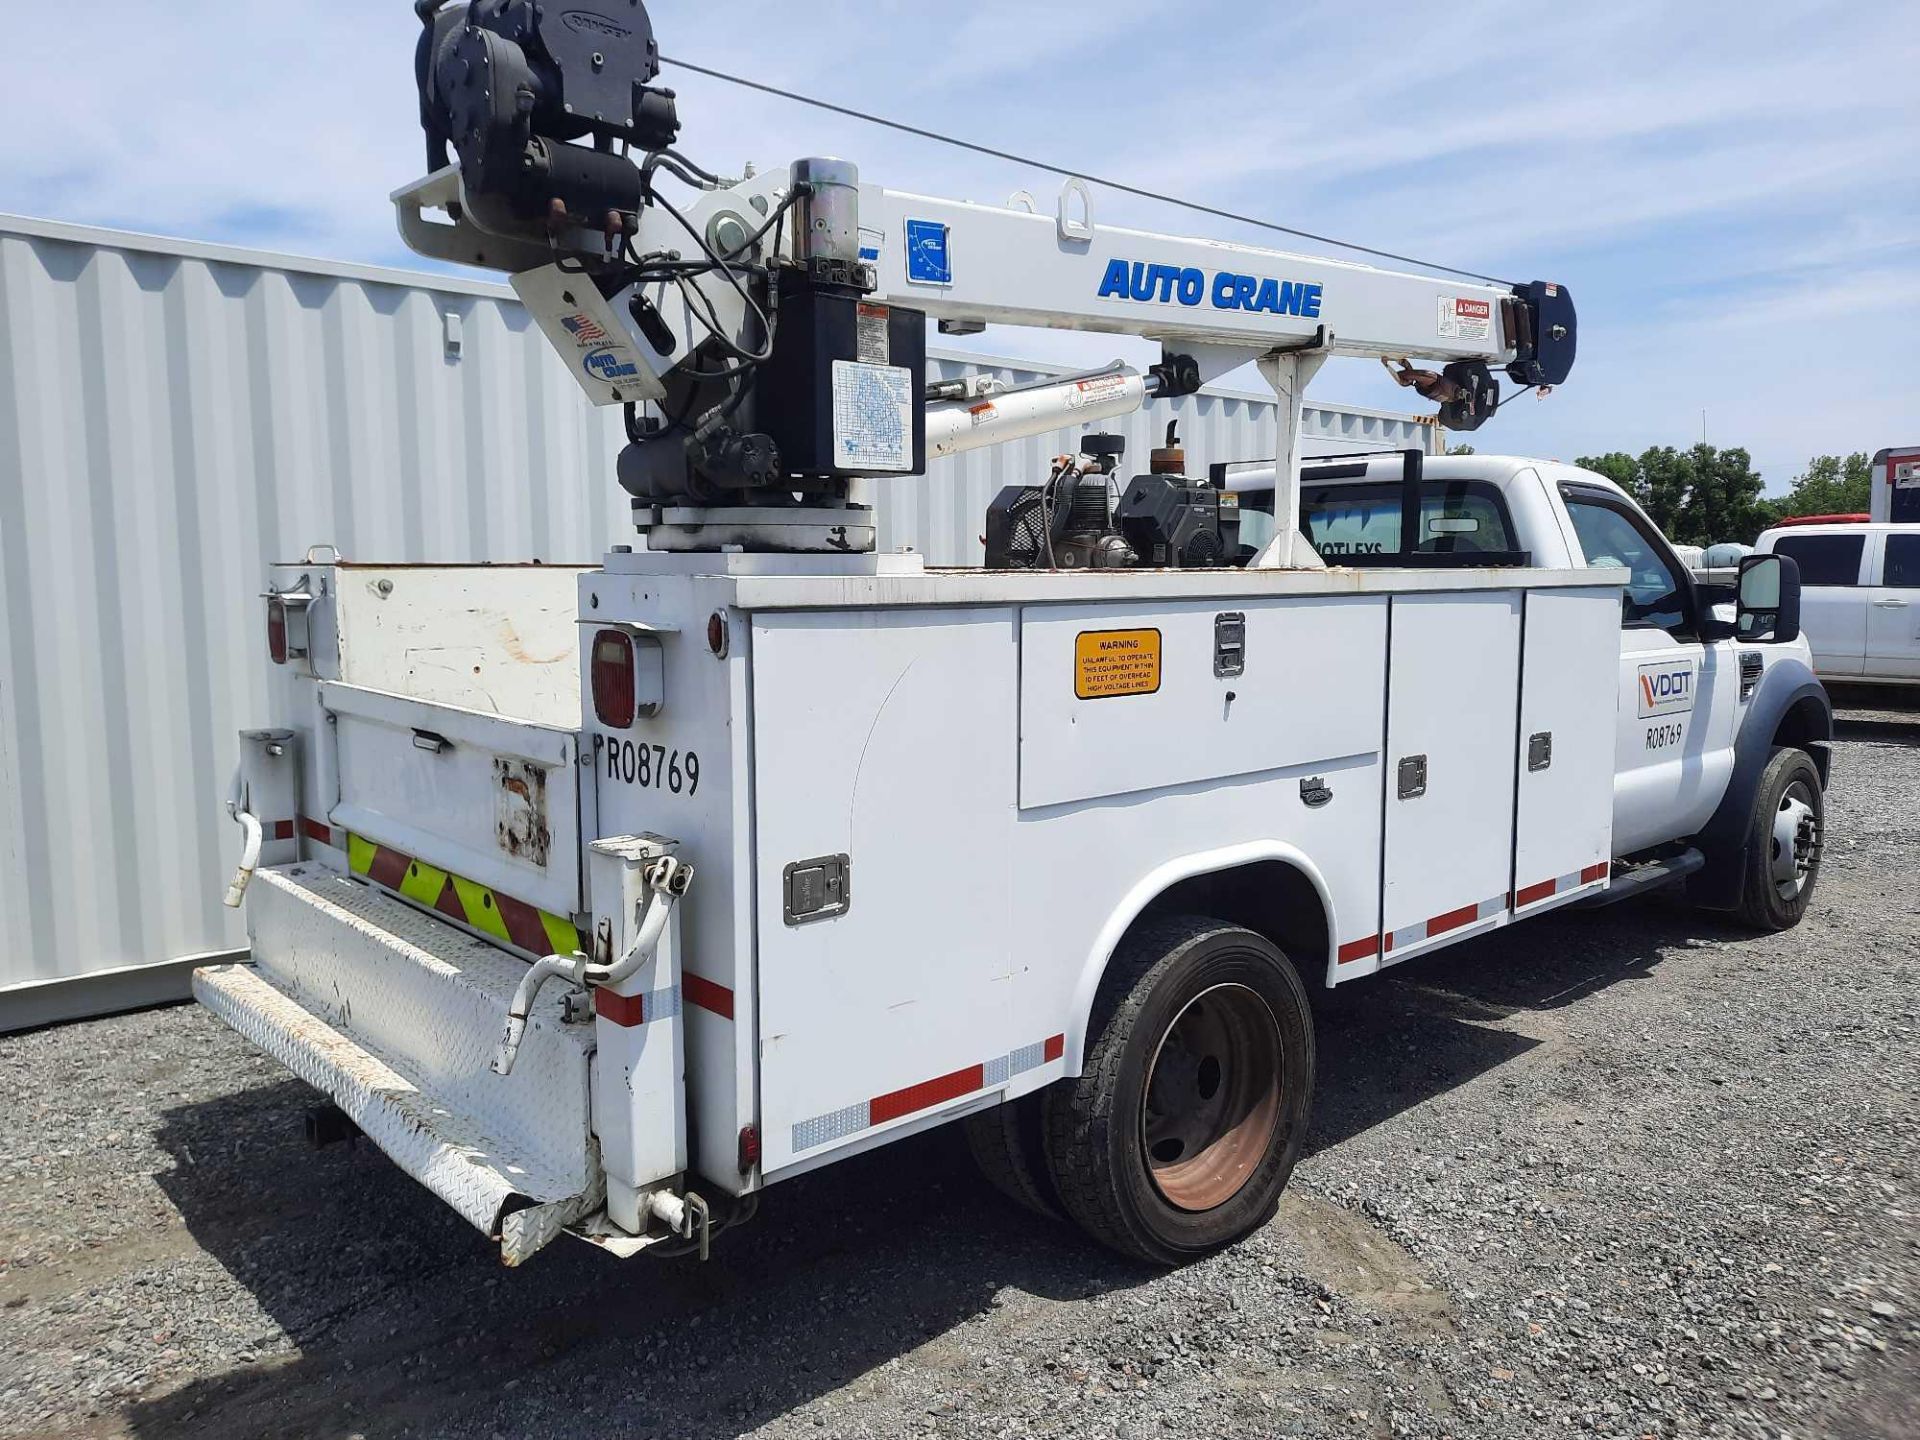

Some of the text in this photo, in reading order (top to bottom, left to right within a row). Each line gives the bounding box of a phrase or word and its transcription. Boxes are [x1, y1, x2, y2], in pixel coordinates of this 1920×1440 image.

[1097, 258, 1323, 318] AUTO CRANE
[1464, 303, 1488, 315] DANGER
[589, 353, 617, 369] AUTO
[1099, 640, 1139, 650] WARNING
[1082, 656, 1116, 664] UNLAWFUL
[1126, 653, 1154, 661] OPERATE
[1098, 663, 1133, 672] EQUIPMENT
[1093, 674, 1109, 682] FEET
[1118, 671, 1151, 680] OVERHEAD
[1103, 682, 1131, 690] VOLTAGE
[1131, 680, 1149, 688] LINES
[1648, 671, 1692, 697] VDOT
